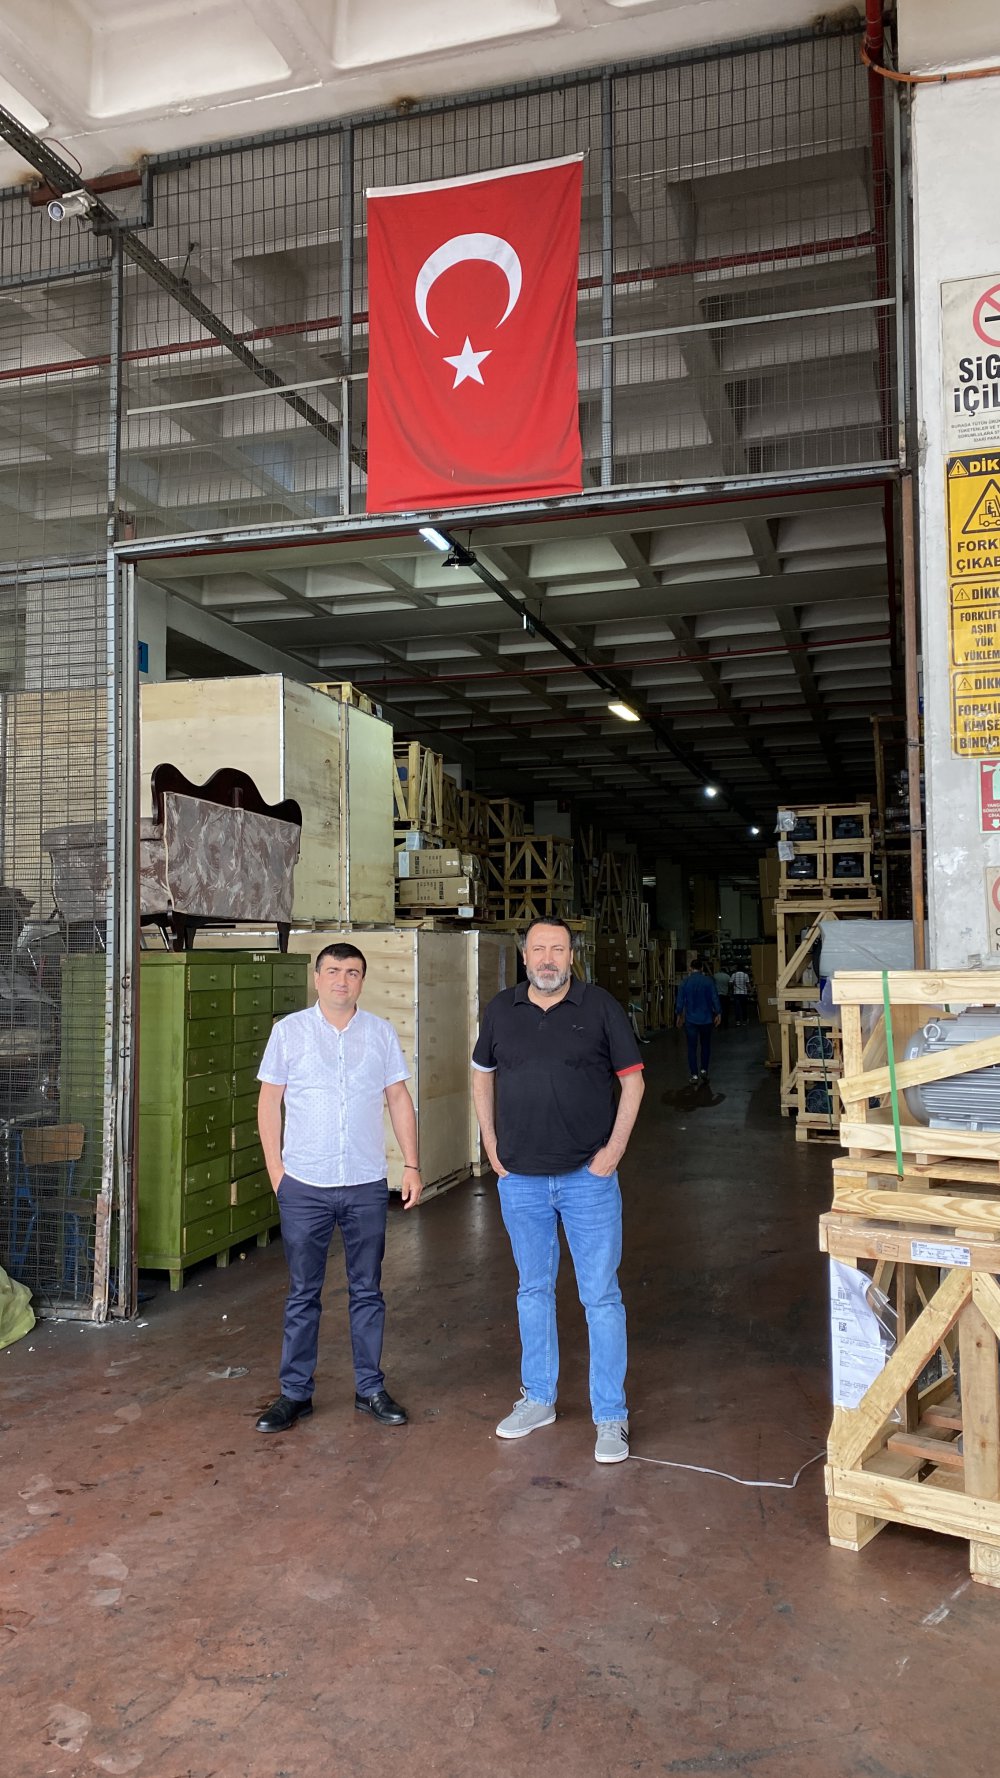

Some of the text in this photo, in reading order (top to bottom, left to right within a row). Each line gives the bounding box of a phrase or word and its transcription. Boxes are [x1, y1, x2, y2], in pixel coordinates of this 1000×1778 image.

[969, 457, 1000, 474] DİK
[957, 538, 1000, 553] FORK
[971, 586, 1000, 600] DİKK
[971, 623, 997, 635] AŞIRI
[975, 636, 993, 647] YÜK
